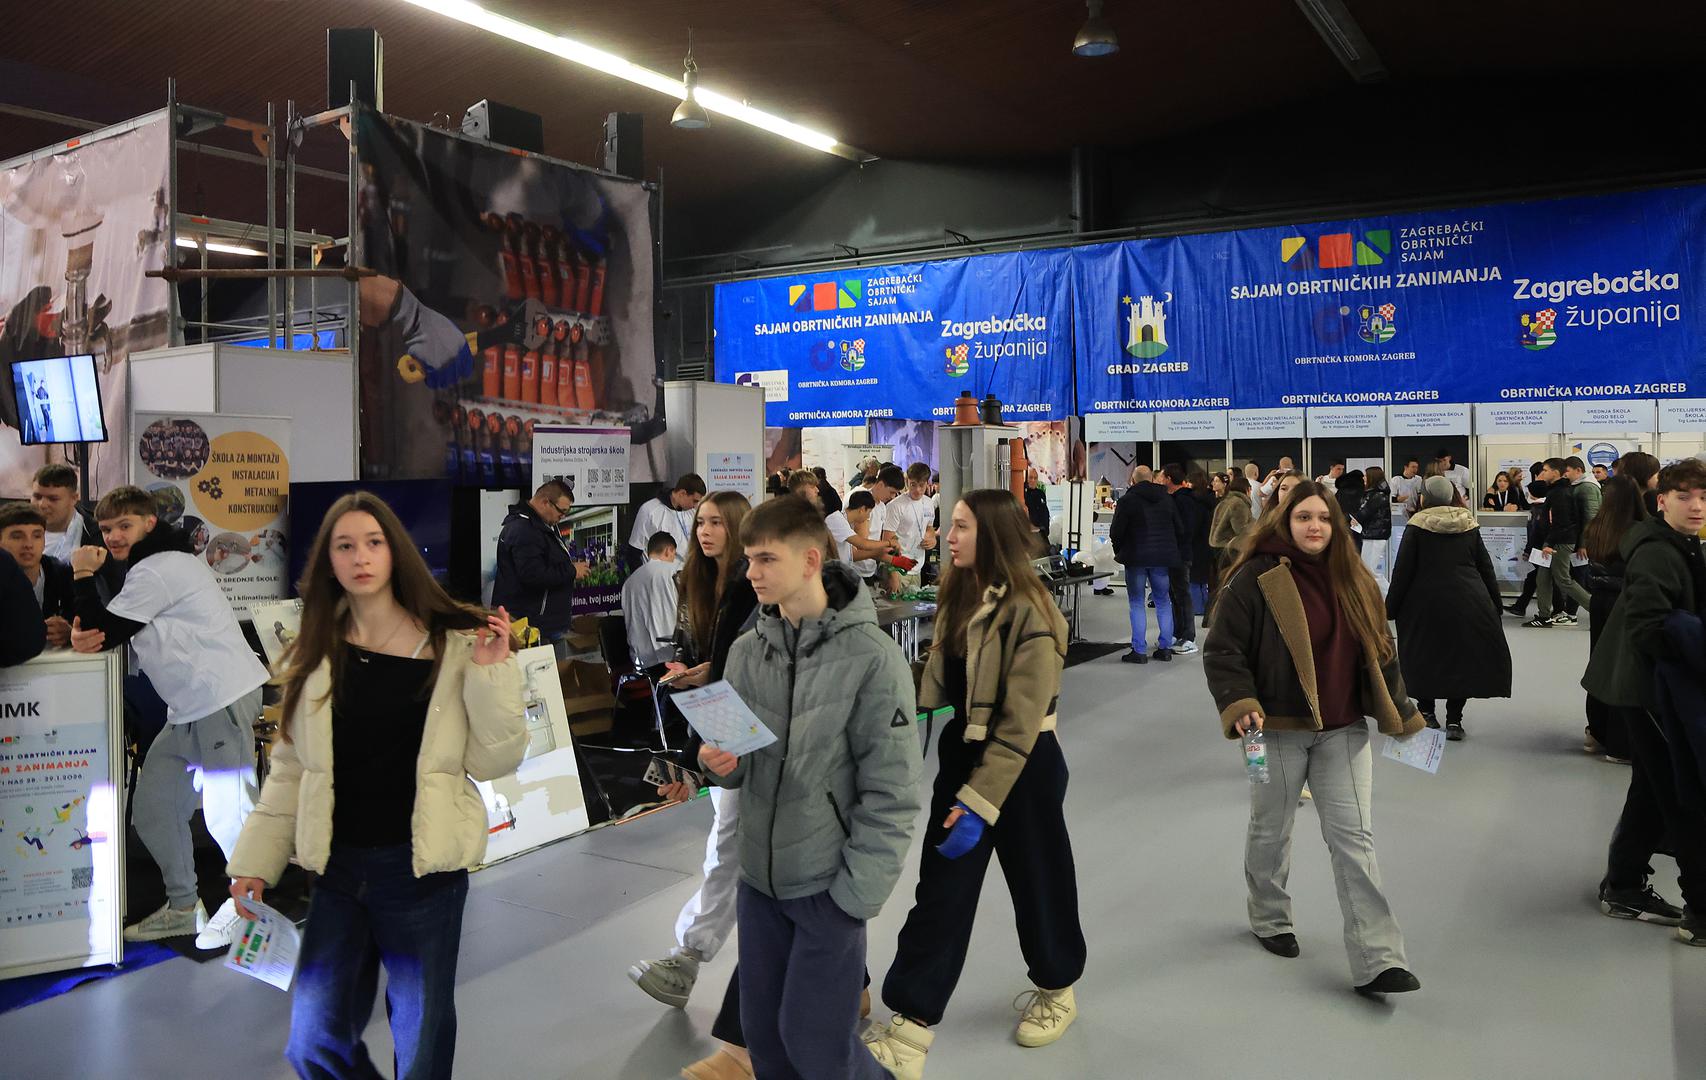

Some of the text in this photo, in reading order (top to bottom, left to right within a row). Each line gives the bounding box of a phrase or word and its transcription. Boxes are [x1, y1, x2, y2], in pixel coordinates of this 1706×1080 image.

[1400, 220, 1484, 238] ZAGREBAČKI
[1401, 234, 1473, 250] OBRTNIČKI
[1401, 249, 1444, 262] SAJAM
[867, 273, 922, 287] ZAGREBAČKI
[1230, 266, 1502, 300] SAJAM OBRTNIČKIH ZANIMANJA
[1513, 269, 1679, 303] Zagrebačka
[867, 284, 915, 296] OBRTNIČKI
[867, 296, 897, 306] SAJAM
[1566, 300, 1680, 331] županija
[754, 309, 934, 336] SAJAM OBRTNIČKIH ZANIMANJA
[941, 313, 1046, 340] Zagrebačka
[974, 338, 1047, 361] županija
[1294, 352, 1416, 365] OBRTNIČKA KOMORA ZAGREB
[1107, 361, 1189, 375] GRAD ZAGREB
[798, 378, 879, 388] OBRTNIČKA KOMORA ZAGREB
[1282, 390, 1439, 404] OBRTNIČKA KOMORA ZAGREB
[1501, 382, 1686, 399] OBRTNIČKA KOMORA ZAGREB
[1016, 403, 1052, 413] ZAGREB
[1094, 397, 1230, 410] OBRTNIČKA KOMORA ZAGREB
[789, 408, 893, 420] OBRTNIČKA KOMORA ZAGREB
[540, 445, 625, 456] Industrijska strojarska škola
[212, 451, 280, 464] ŠKOLA ZA MONTAŽU
[232, 470, 280, 480] INSTALACIJA I
[244, 487, 279, 497] METALNIH
[228, 503, 279, 514] KONSTRUKCIJA
[223, 576, 254, 584] SREDNJE
[256, 574, 280, 583] ŠKOLE:
[238, 593, 279, 601] klimatizacije
[589, 593, 602, 605] tvoj
[16, 759, 89, 773] ZANIMANJA
